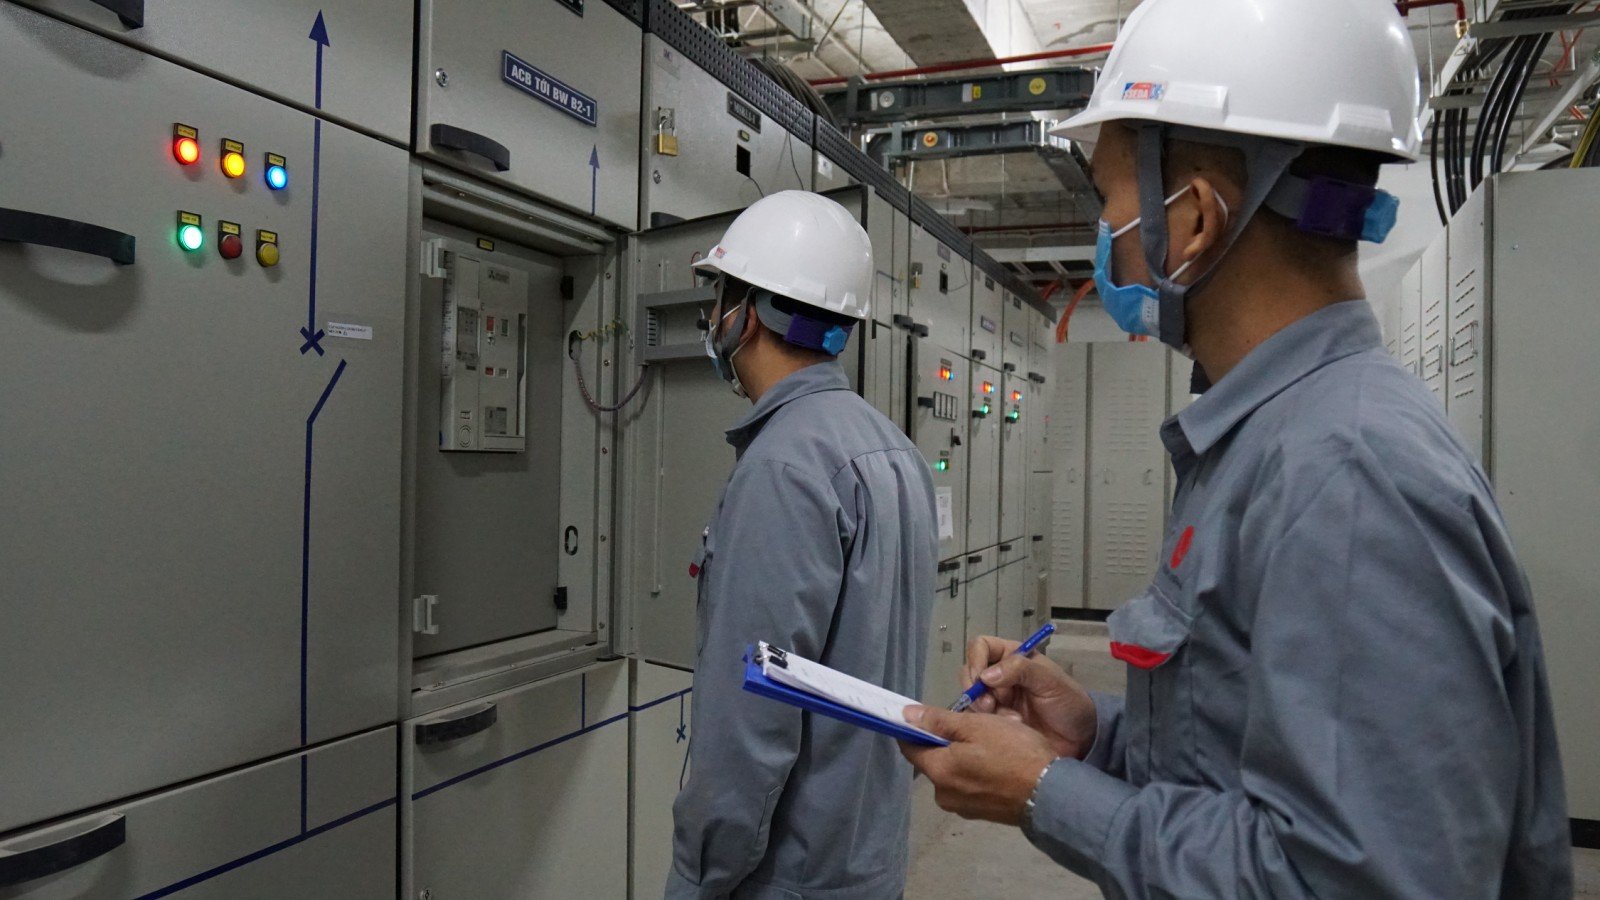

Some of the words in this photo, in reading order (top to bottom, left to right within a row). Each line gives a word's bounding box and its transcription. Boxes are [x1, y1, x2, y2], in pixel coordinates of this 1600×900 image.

[511, 64, 532, 85] ACB
[535, 76, 550, 96] TỚI
[553, 87, 568, 105] BW
[571, 96, 591, 116] B2-1
